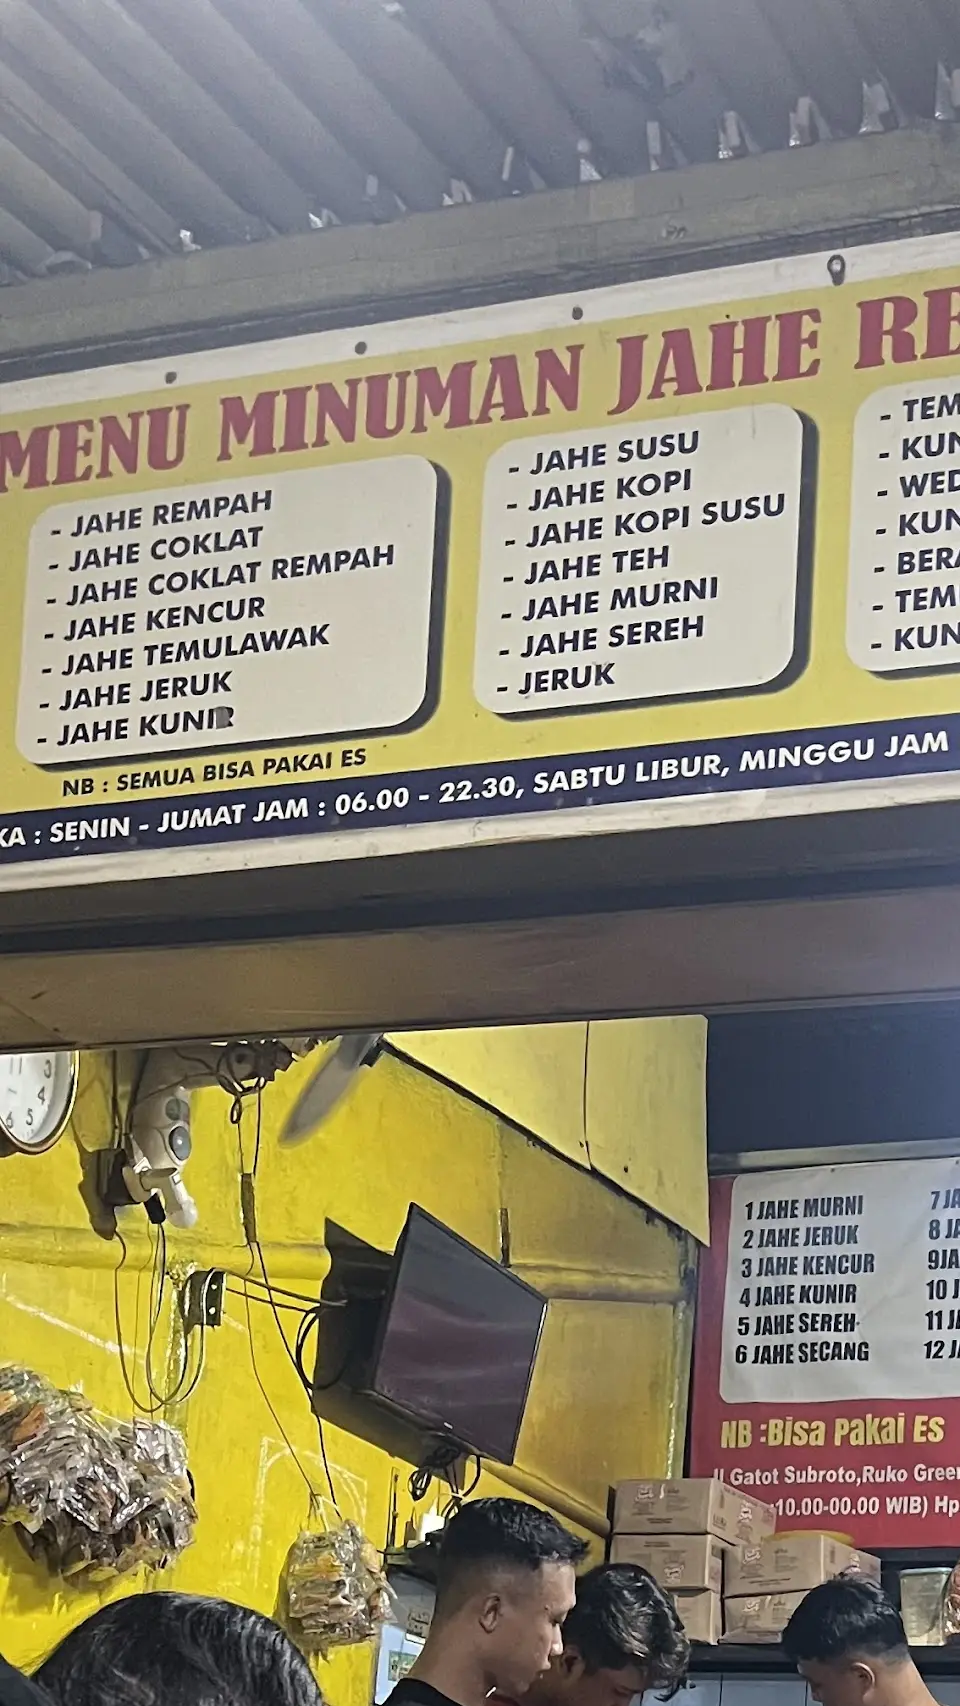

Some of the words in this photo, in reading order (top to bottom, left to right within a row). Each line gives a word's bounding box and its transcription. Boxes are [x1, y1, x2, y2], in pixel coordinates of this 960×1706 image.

[0, 404, 190, 493] MENU
[217, 342, 588, 461] MINUMAN
[607, 309, 821, 415] JAHE
[530, 444, 606, 475] JAHE
[618, 431, 698, 462] SUSU
[71, 508, 142, 537] JAHE
[153, 490, 271, 525] REMPAH
[69, 543, 139, 571] JAHE
[151, 526, 263, 560] COKLAT
[523, 591, 599, 621] JAHE
[610, 577, 717, 610] MURNI
[62, 648, 133, 675] JAHE
[144, 624, 329, 665] TEMULAWAK
[519, 663, 615, 694] JERUK
[63, 778, 94, 796] NB
[117, 768, 194, 791] SEMUA
[203, 761, 254, 781] BISA
[263, 752, 332, 775] PAKAI
[341, 749, 365, 767] ES
[50, 817, 129, 842] SENIN
[157, 804, 246, 832] JUMAT
[253, 798, 308, 821] JAM
[336, 788, 409, 814] 06.00
[439, 776, 524, 803] 22.30,
[534, 764, 625, 793] SABTU
[636, 755, 729, 781] LIBUR,
[740, 739, 874, 771] MINGGU
[884, 731, 948, 757] JAM
[746, 1202, 753, 1220] 1
[757, 1200, 799, 1219] JAHE
[803, 1195, 863, 1217] MURNI
[931, 1191, 940, 1210] 7
[743, 1230, 753, 1248] 2
[758, 1228, 799, 1248] JAHE
[803, 1225, 858, 1246] JERUK
[929, 1219, 940, 1240] 8
[742, 1258, 751, 1278] 3
[756, 1257, 798, 1277] JAHE
[803, 1254, 874, 1275] KENCUR
[739, 1288, 750, 1307] 4
[755, 1285, 794, 1306] JAHE
[799, 1284, 856, 1304] KUNIR
[926, 1280, 947, 1300] 10
[738, 1317, 749, 1335] 5
[754, 1314, 794, 1335] JAHE
[799, 1313, 855, 1333] SEREH
[925, 1311, 942, 1330] 11
[736, 1345, 747, 1363] 6
[752, 1344, 794, 1364] JAHE
[799, 1341, 868, 1363] SECANG
[924, 1341, 944, 1358] 12
[721, 1420, 752, 1448] NB
[835, 1413, 905, 1446] Pakai
[914, 1416, 944, 1442] Es
[730, 1468, 778, 1485] Gatot
[886, 1496, 927, 1518] WIB)
